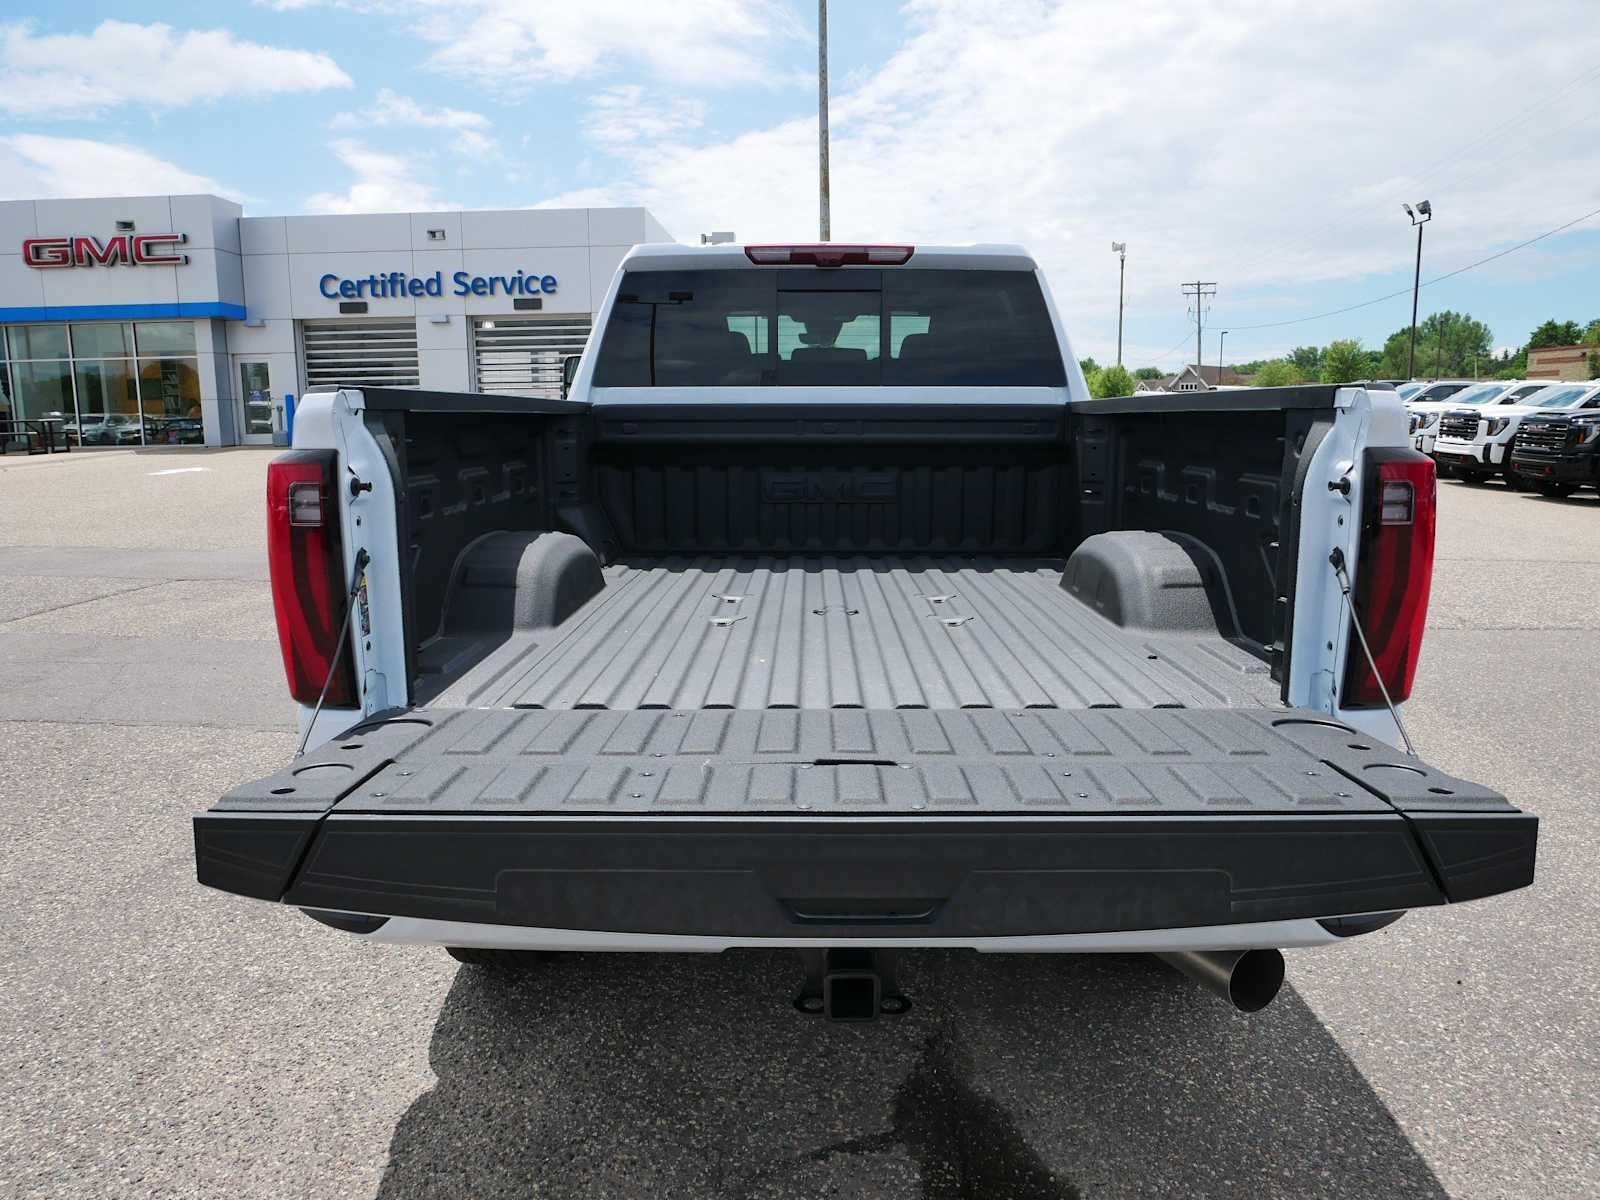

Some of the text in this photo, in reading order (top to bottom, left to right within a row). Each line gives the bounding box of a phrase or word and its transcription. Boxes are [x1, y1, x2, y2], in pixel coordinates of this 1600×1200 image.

[24, 234, 189, 268] GMC
[319, 270, 557, 299] Certified Service
[761, 471, 897, 503] GMC
